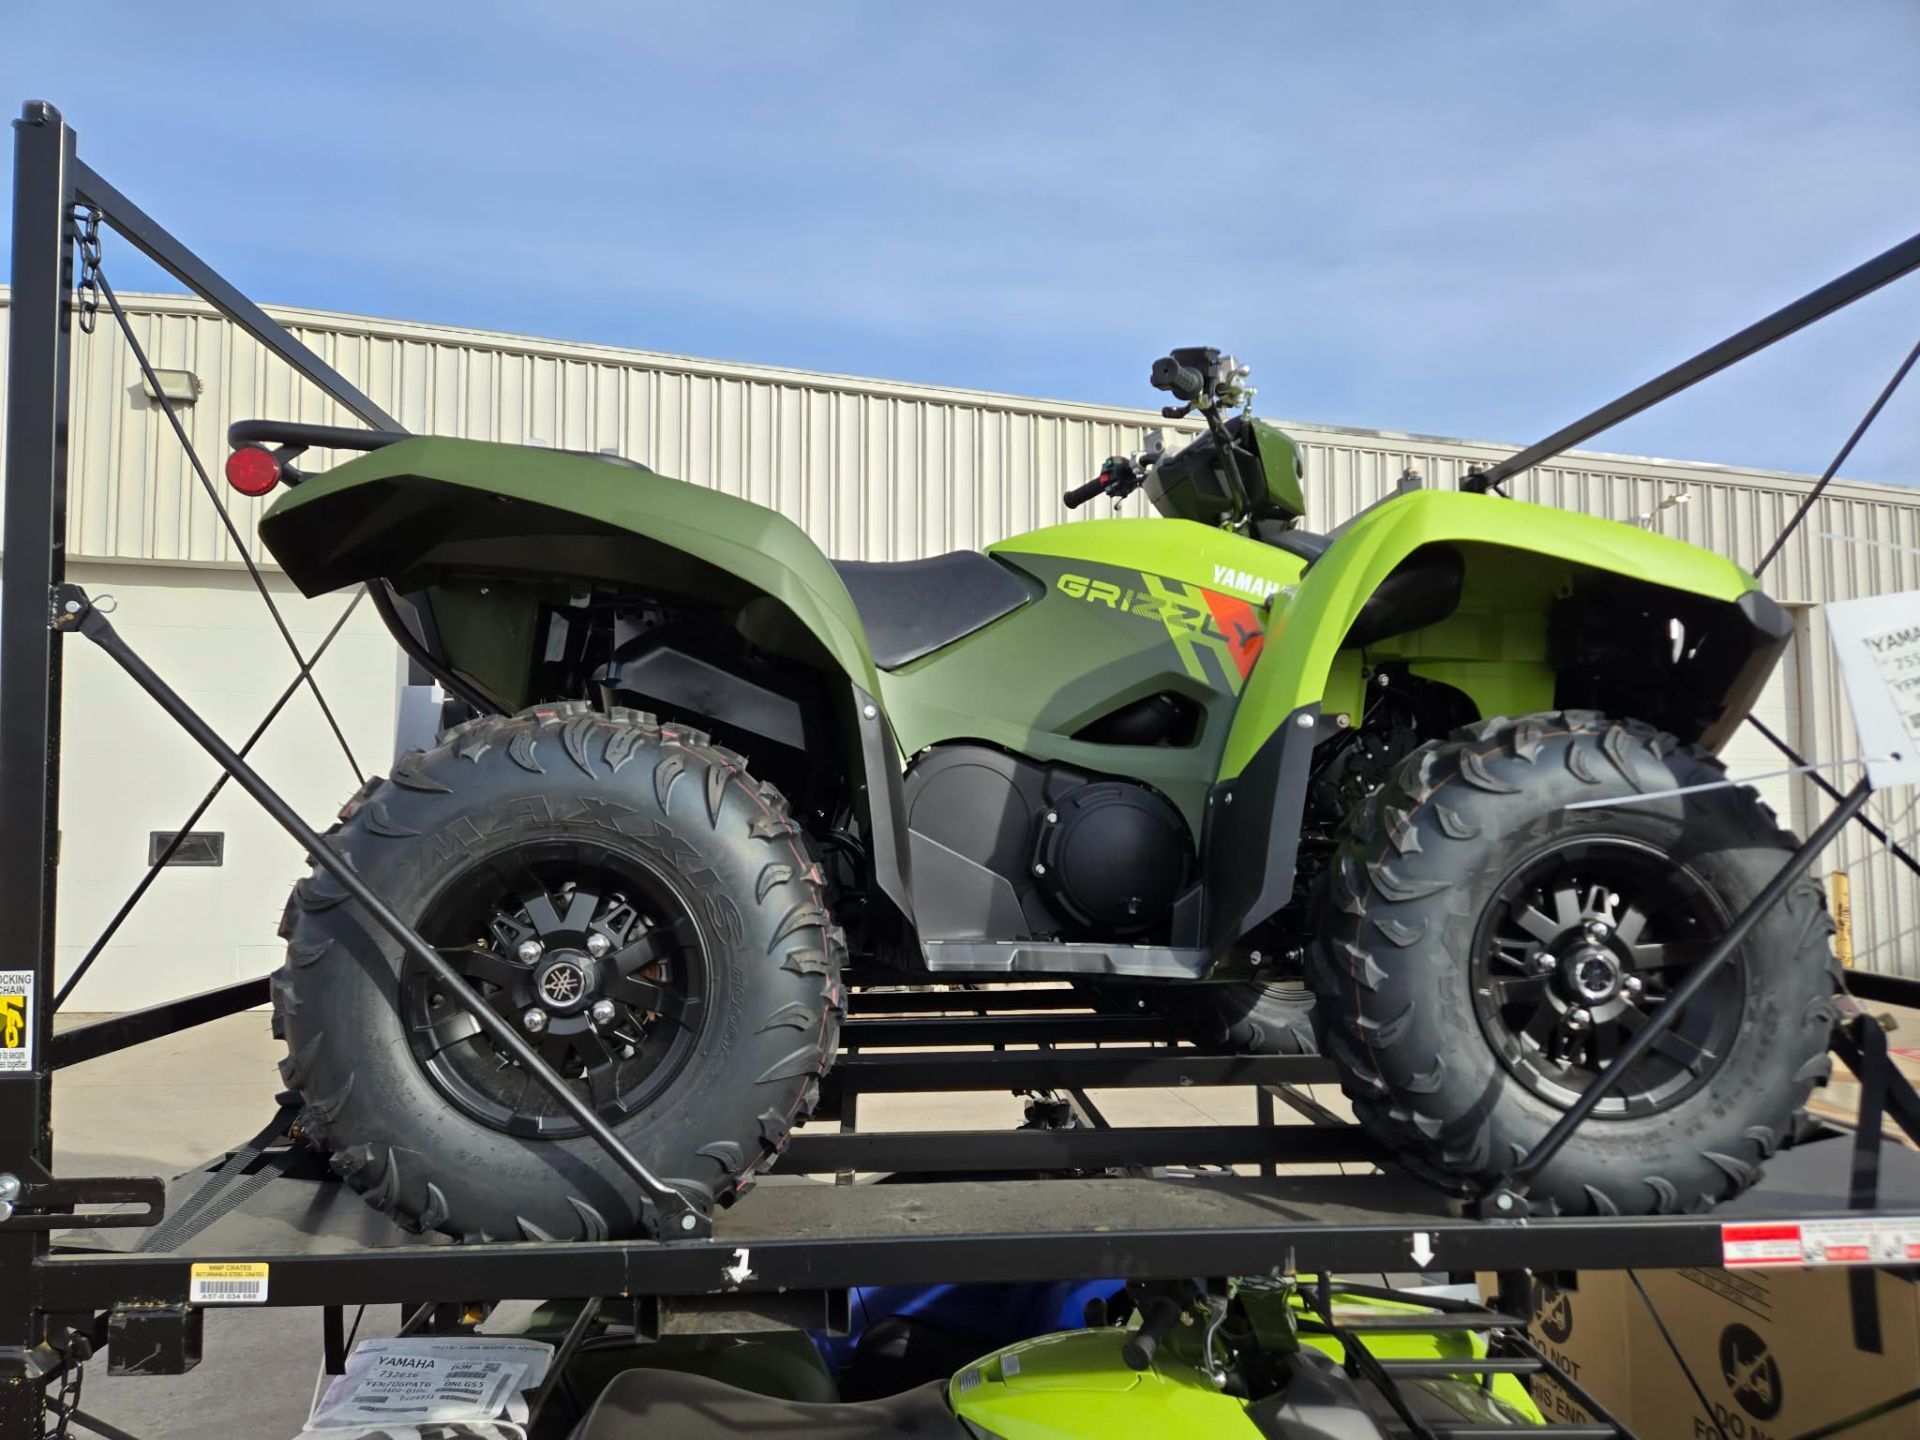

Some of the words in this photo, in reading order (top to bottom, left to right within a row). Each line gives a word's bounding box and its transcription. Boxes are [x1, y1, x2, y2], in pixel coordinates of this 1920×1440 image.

[1212, 563, 1288, 601] YAMAH
[1056, 572, 1266, 648] GRIZZLY
[420, 794, 745, 948] MAXXIS
[379, 1356, 435, 1369] YAMAHA
[1550, 1347, 1581, 1380] NOT
